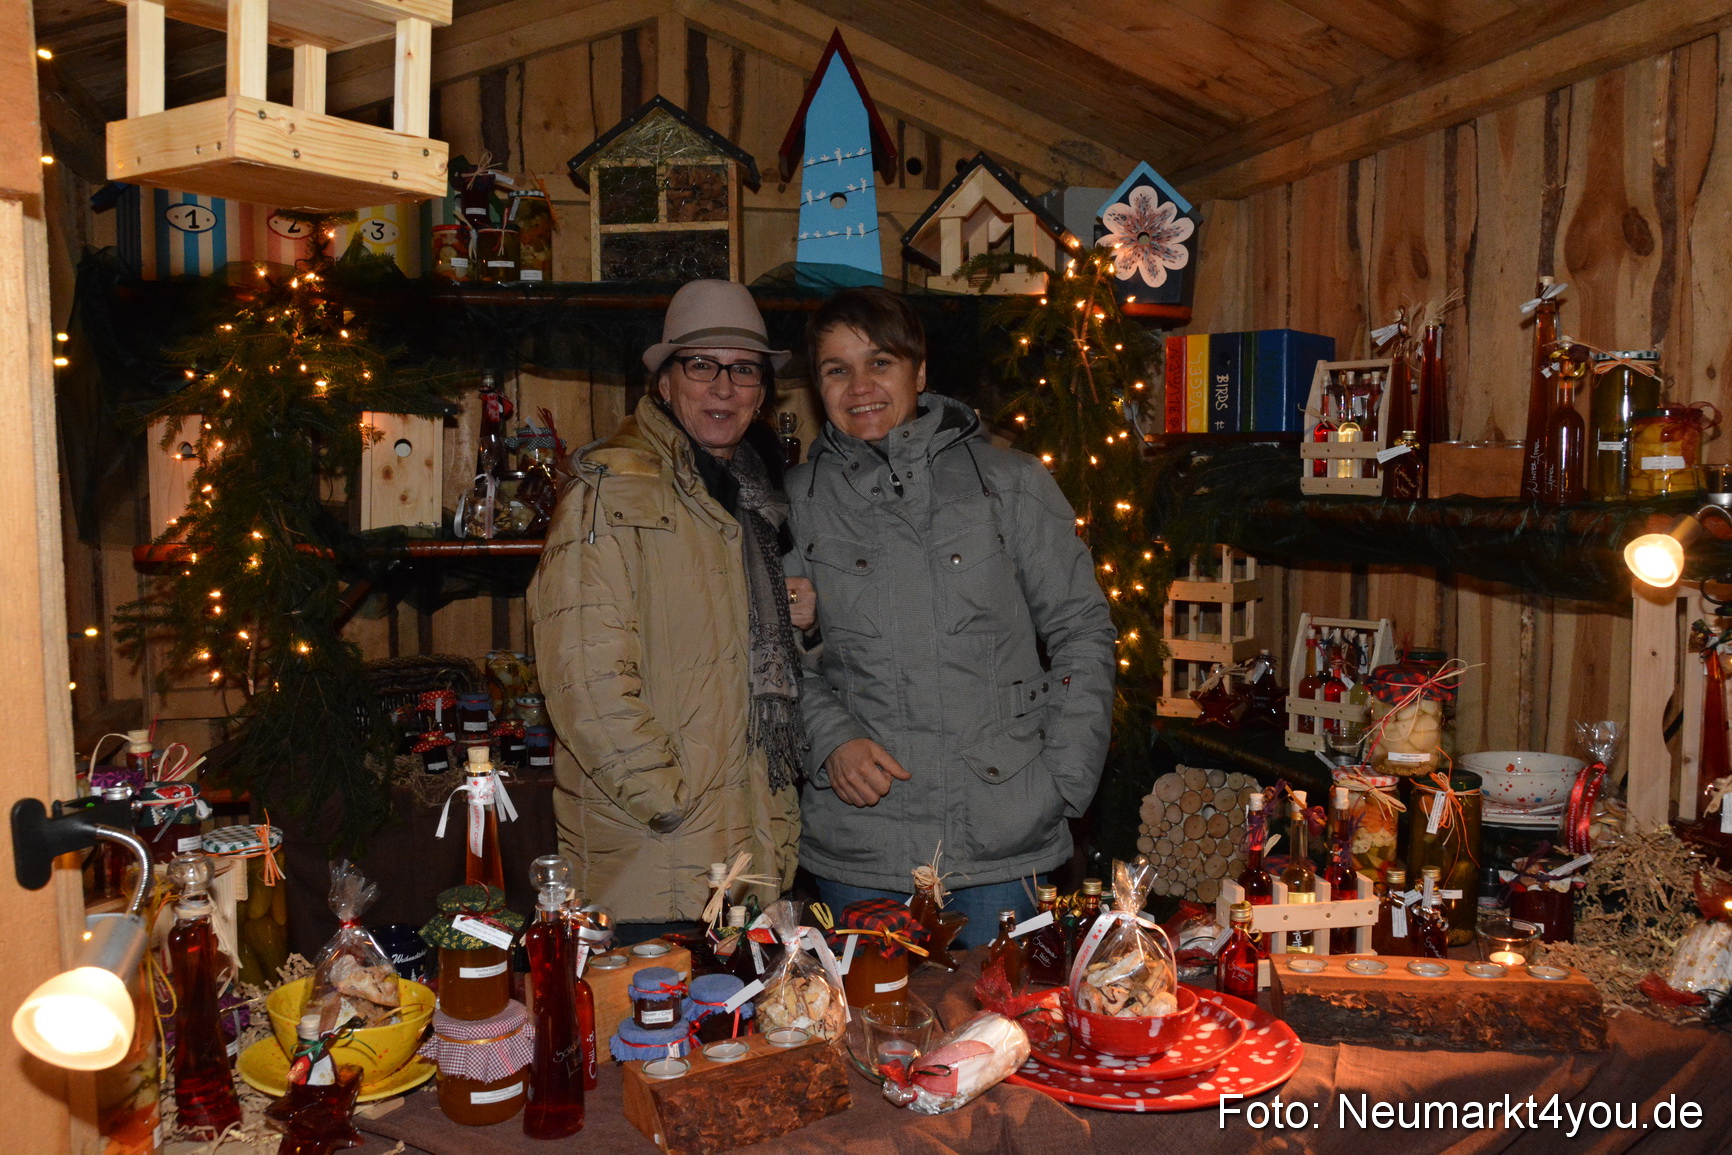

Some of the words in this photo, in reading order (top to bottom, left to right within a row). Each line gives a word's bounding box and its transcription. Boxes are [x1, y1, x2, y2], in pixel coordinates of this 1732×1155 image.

[184, 208, 200, 229] 1
[370, 220, 385, 240] 3
[1214, 373, 1230, 411] BIRDS
